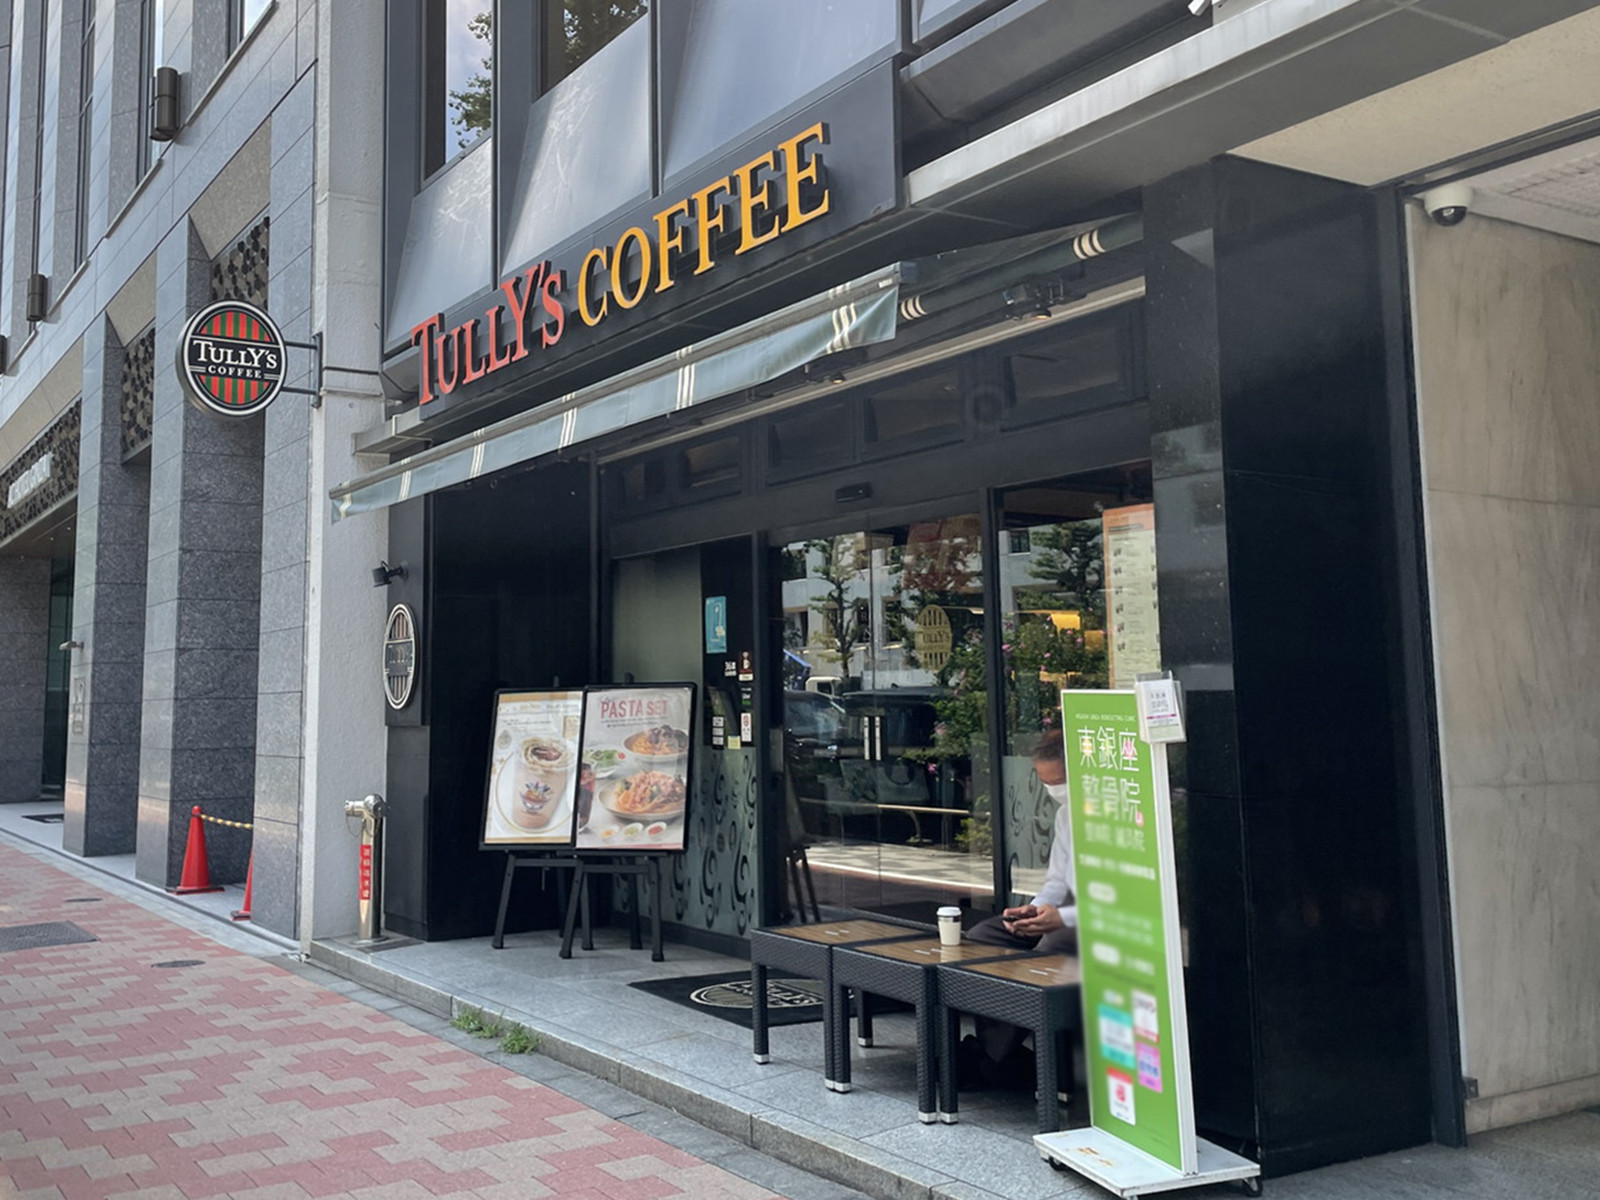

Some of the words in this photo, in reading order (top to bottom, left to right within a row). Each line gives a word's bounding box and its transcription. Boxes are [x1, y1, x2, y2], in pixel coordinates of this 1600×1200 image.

[412, 262, 565, 405] TULLY'S
[577, 122, 830, 327] COFFEE
[193, 340, 277, 369] TULLY'S
[208, 365, 262, 378] COFFEE
[600, 699, 643, 718] PASTA
[647, 699, 668, 715] SET
[1077, 725, 1140, 771] 東銀座
